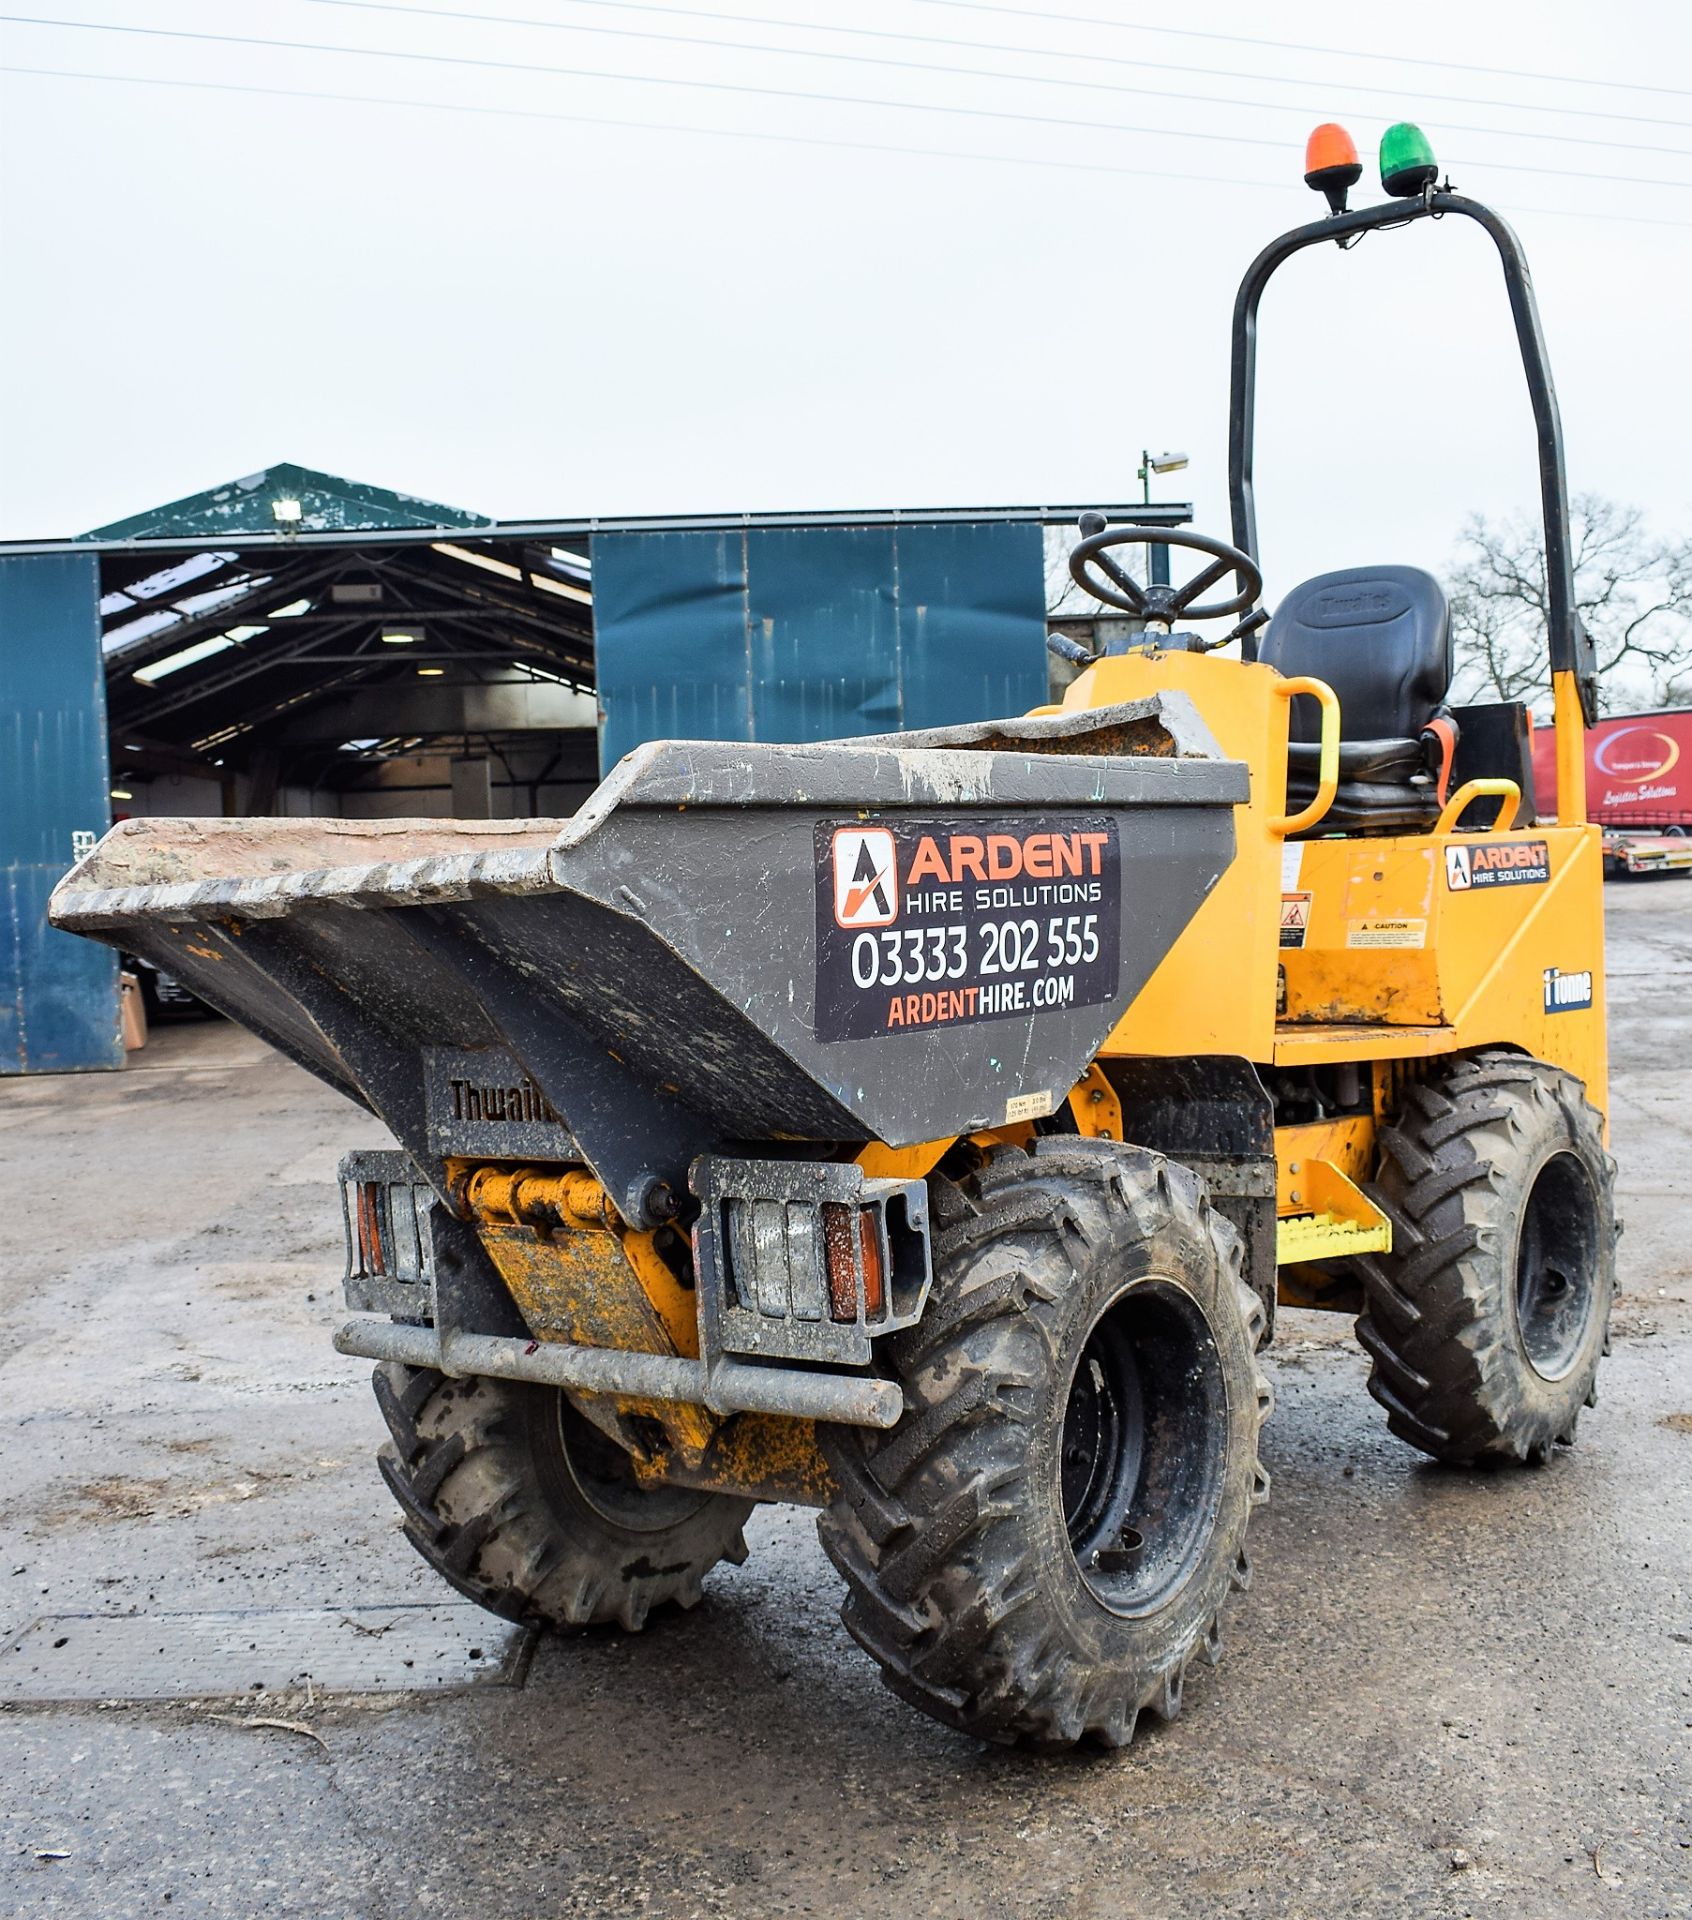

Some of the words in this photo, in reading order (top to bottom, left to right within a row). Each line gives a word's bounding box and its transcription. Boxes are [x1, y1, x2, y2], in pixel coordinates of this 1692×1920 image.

[906, 833, 1109, 885] ARDENT
[1472, 845, 1547, 870] ARDENT
[1472, 872, 1495, 883] HIRE
[1497, 868, 1547, 881] SOLUTIONS
[906, 891, 963, 914] HIRE
[976, 882, 1102, 910] SOLUTIONS
[851, 925, 968, 989] 03333
[979, 919, 1040, 974] 202
[1047, 914, 1100, 967] 555
[887, 975, 1075, 1027] ARDENTHIRE.COM
